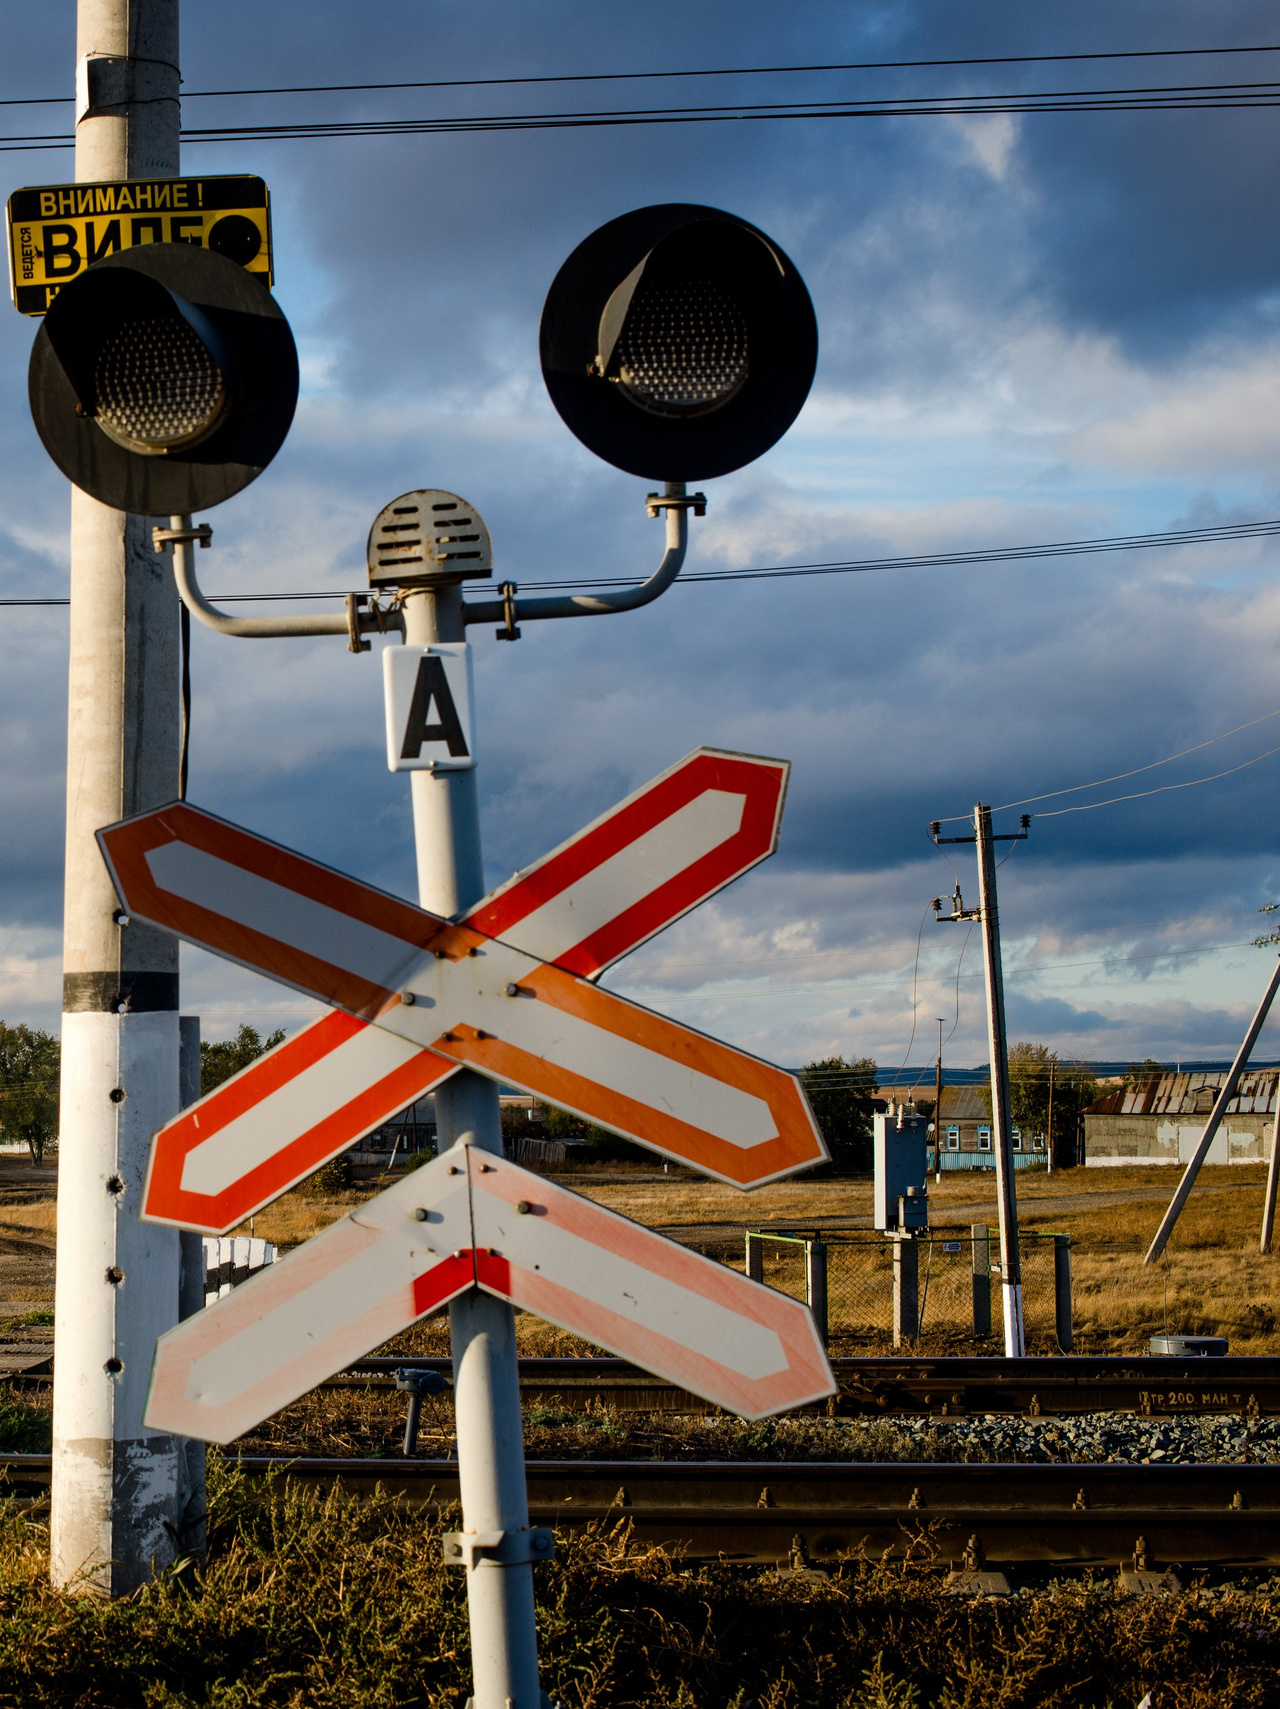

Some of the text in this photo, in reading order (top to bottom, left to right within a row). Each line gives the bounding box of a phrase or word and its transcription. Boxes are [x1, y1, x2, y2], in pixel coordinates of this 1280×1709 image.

[39, 183, 189, 217] ВНИМАНИЕ
[20, 227, 36, 280] ВЕДЕТСЯ
[400, 656, 470, 759] А
